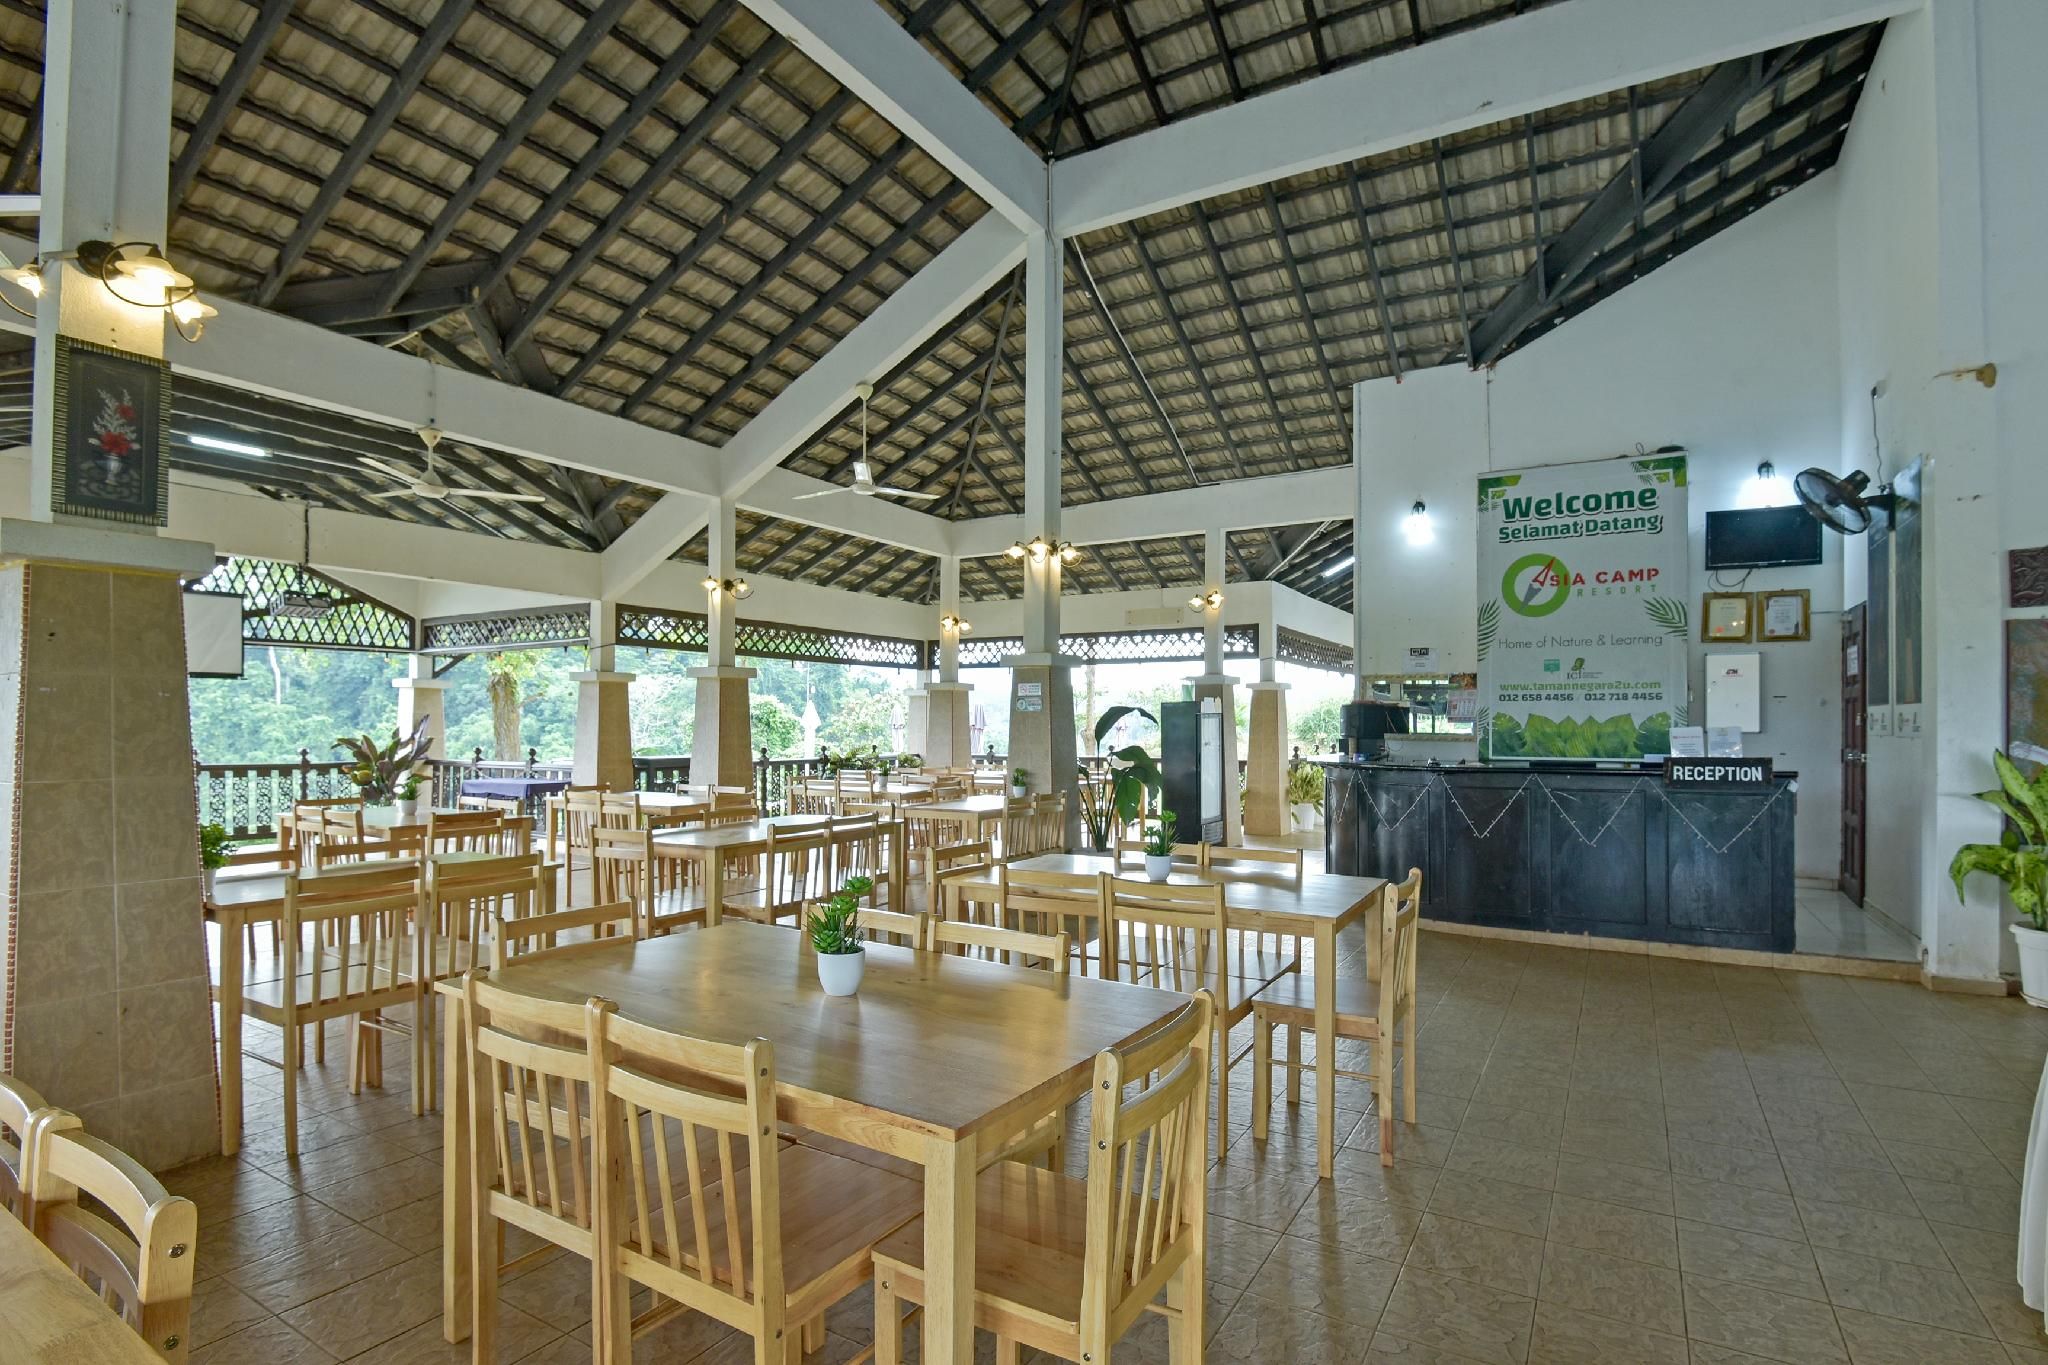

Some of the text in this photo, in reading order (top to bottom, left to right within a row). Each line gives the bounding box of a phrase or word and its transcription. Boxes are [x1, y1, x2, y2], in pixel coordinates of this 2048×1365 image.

[1502, 487, 1658, 521] Welcome
[1499, 515, 1660, 541] Selamat Datang
[1532, 556, 1660, 587] ASIA CAMP
[1577, 584, 1657, 598] RESORT
[1498, 634, 1663, 649] Home of Nature & Learning
[1499, 680, 1661, 691] www.tamannegara2u.com
[1499, 692, 1663, 702] 012 658 4456 012 718 4456
[1673, 766, 1763, 781] RECEPTION
